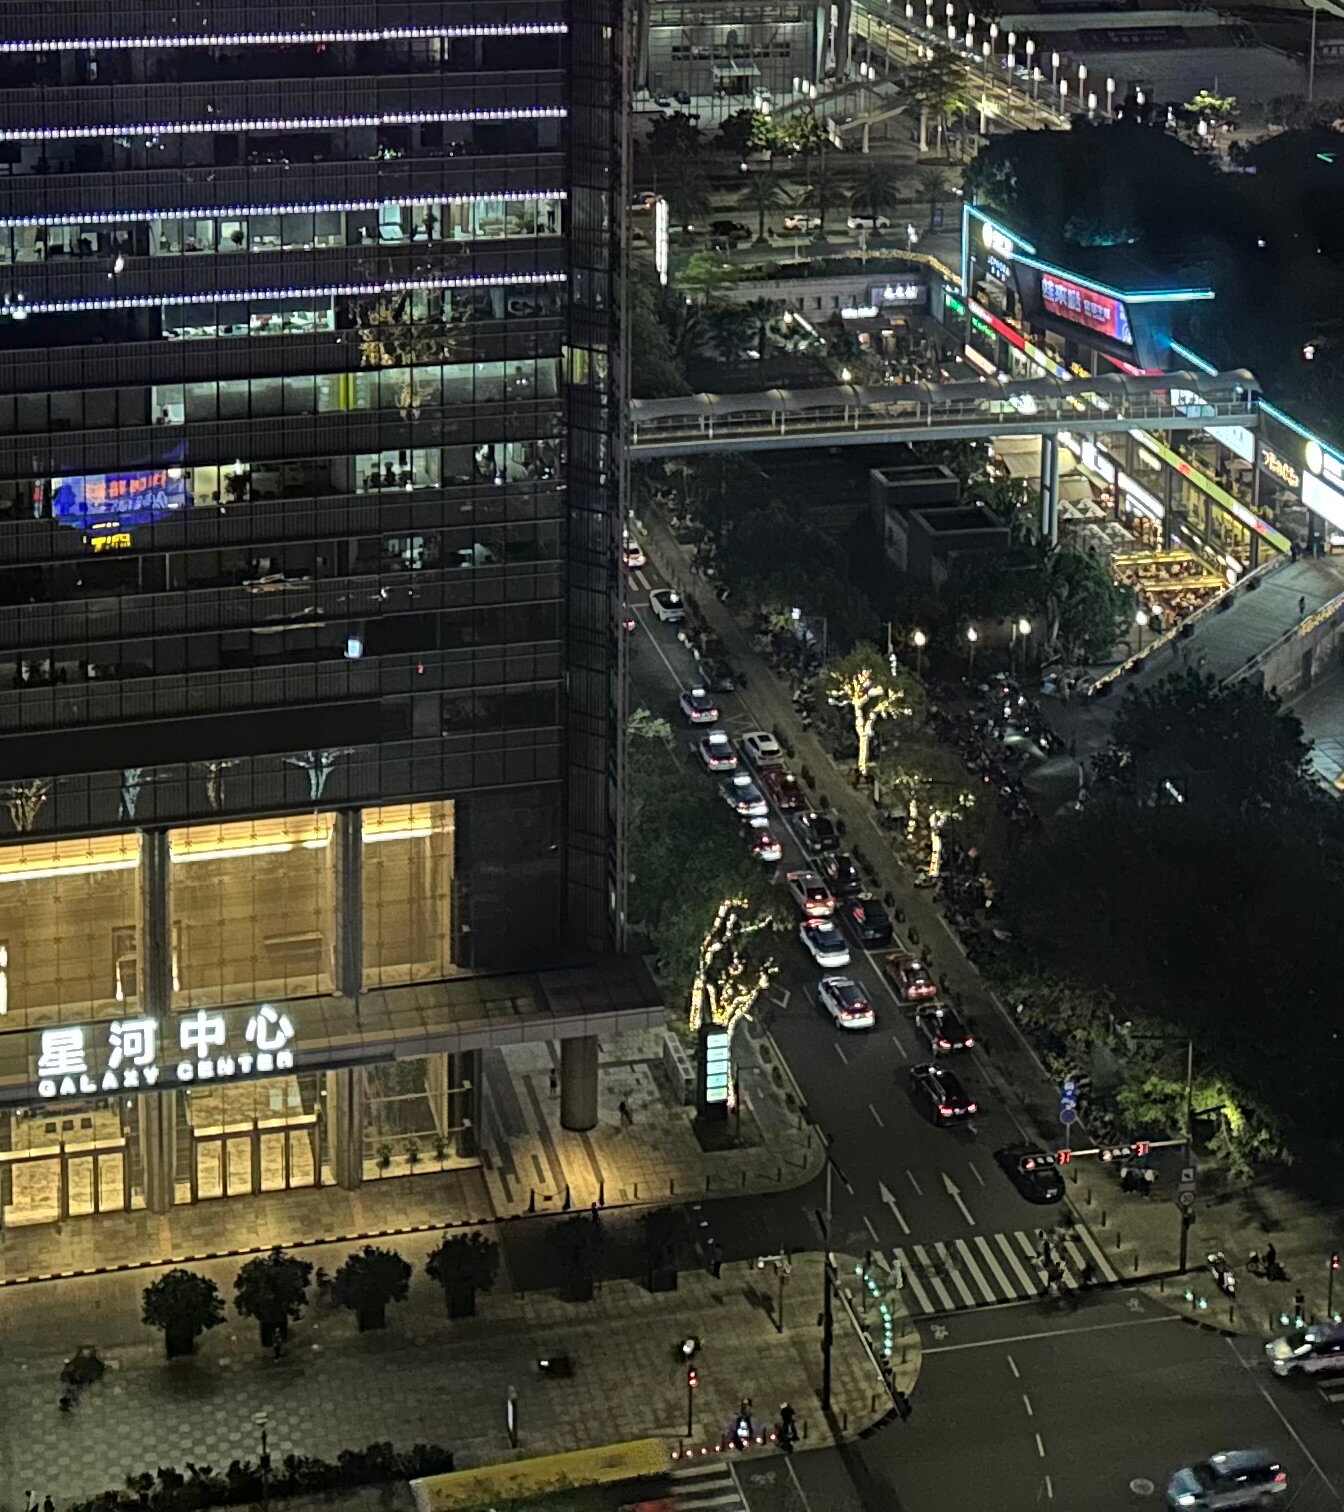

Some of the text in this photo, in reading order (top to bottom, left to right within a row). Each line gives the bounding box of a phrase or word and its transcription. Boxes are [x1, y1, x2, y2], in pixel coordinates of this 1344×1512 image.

[38, 1004, 296, 1077] 星河中心
[38, 1049, 294, 1098] GALAXY CENTER
